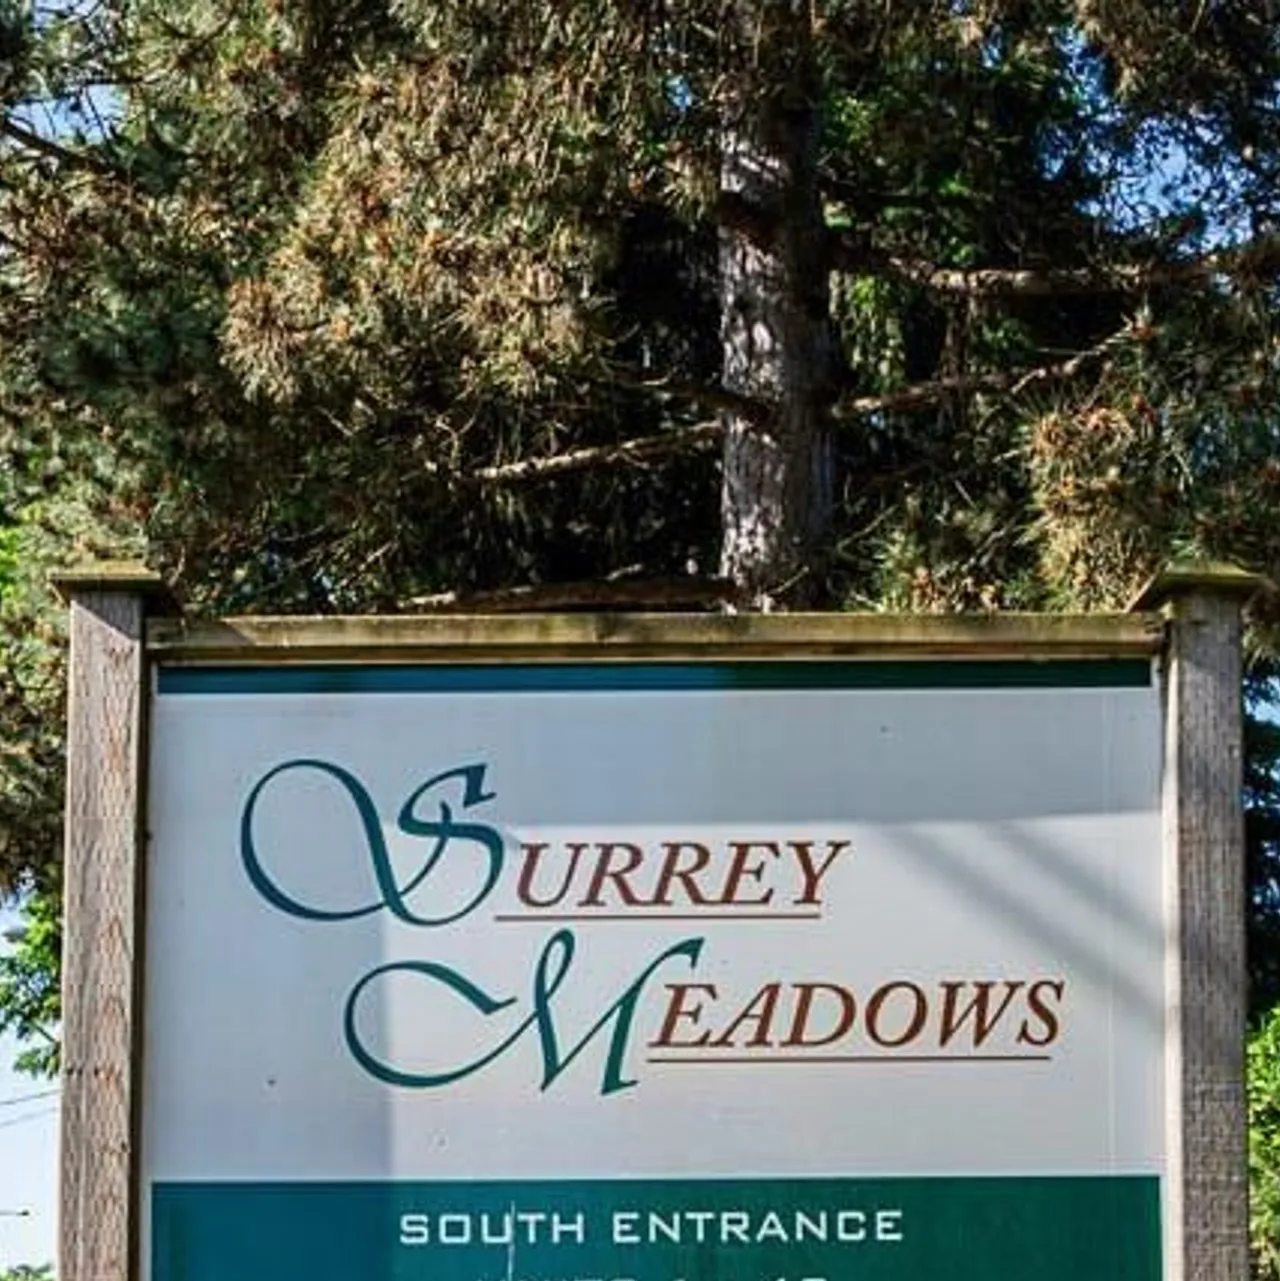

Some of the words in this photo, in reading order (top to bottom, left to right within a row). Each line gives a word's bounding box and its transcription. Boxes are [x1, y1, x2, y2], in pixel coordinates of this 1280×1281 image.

[239, 757, 851, 927] SURREY
[343, 928, 1065, 1096] MEADOWS
[399, 1212, 584, 1245] SOUTH
[612, 1210, 903, 1244] ENTRANCE
